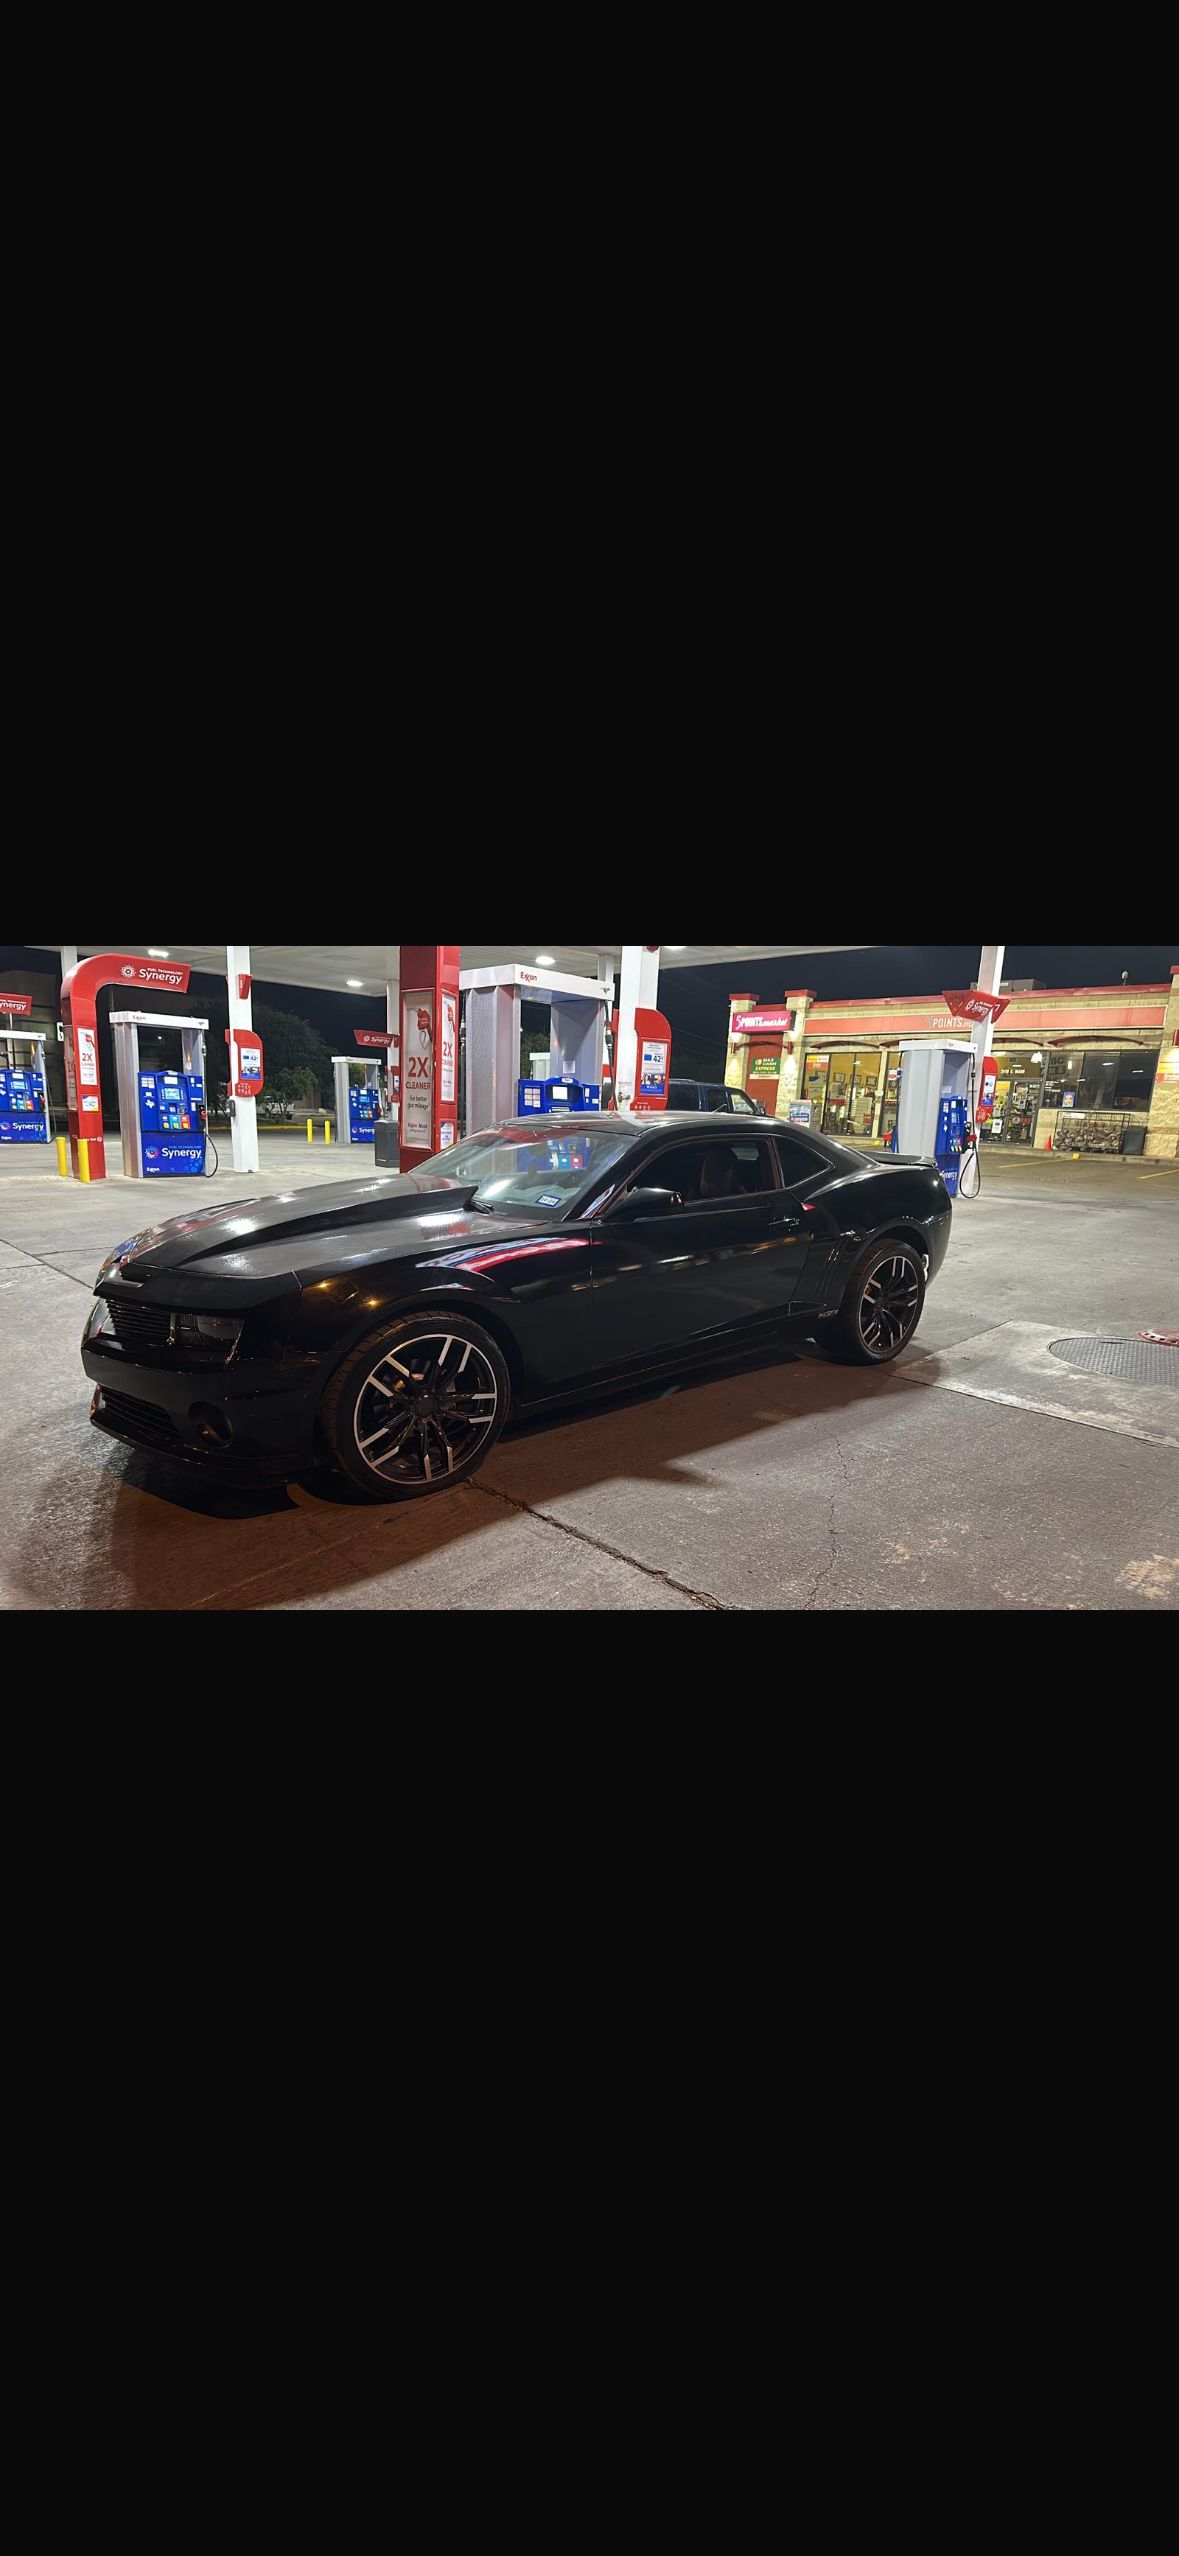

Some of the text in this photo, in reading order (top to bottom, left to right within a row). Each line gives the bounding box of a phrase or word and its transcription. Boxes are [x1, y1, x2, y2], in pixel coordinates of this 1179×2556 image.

[139, 968, 183, 985] Synergy
[520, 971, 538, 983] Exxon
[443, 1041, 453, 1059] 2X
[82, 1053, 93, 1062] 2X
[408, 1056, 429, 1078] 2X
[405, 1081, 431, 1090] CLEANER
[12, 1122, 44, 1132] Synergy
[162, 1147, 202, 1159] Synergy
